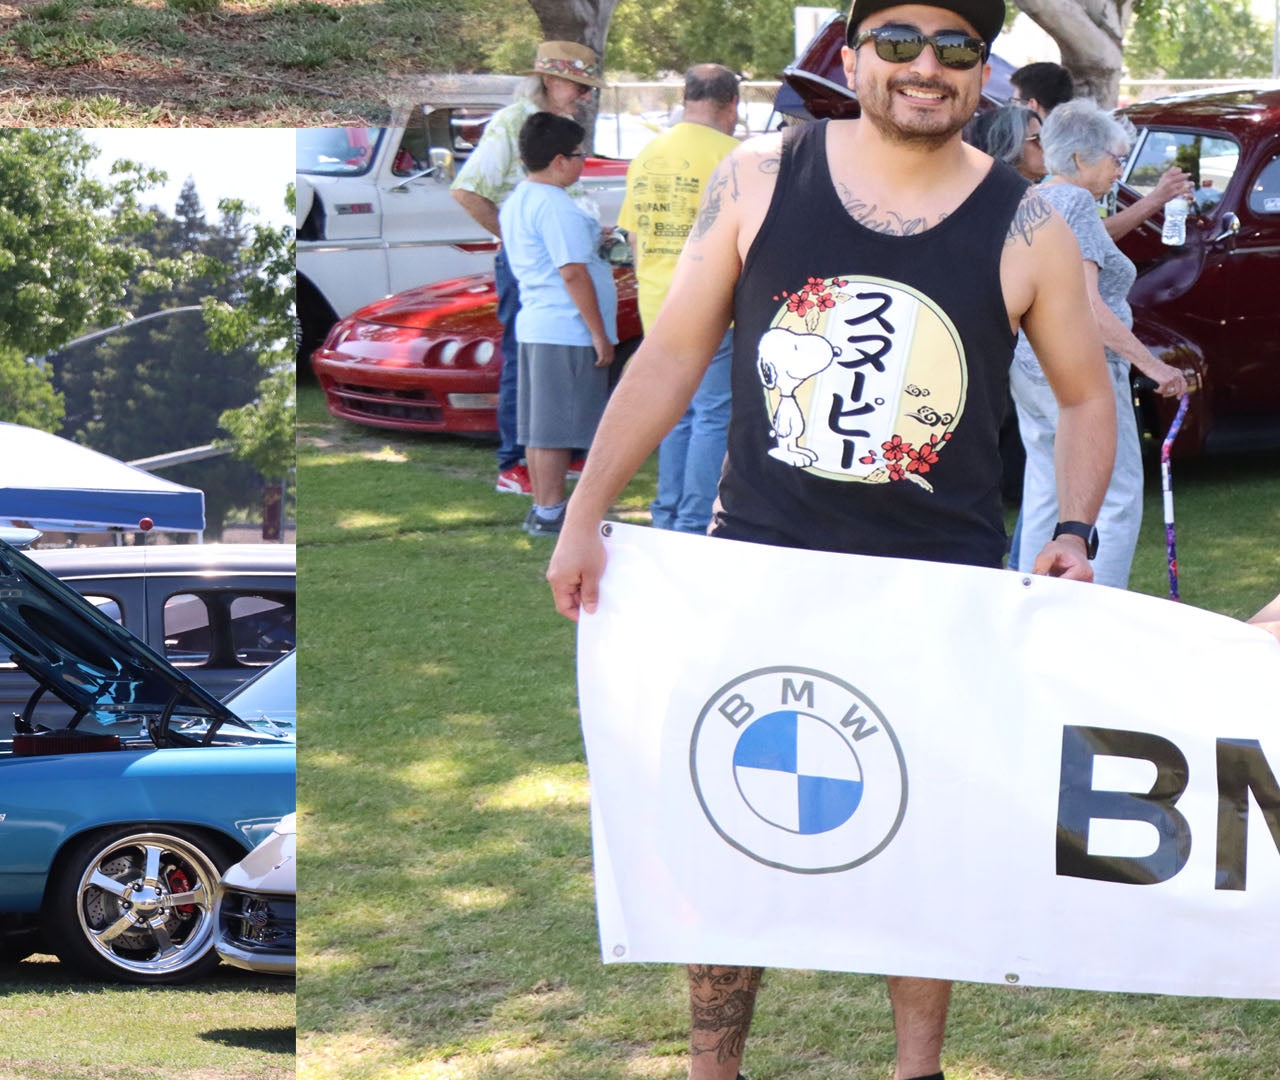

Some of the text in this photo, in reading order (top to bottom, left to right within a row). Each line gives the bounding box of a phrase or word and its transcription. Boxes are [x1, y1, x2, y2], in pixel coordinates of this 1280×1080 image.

[828, 292, 895, 470] スヌーピー
[718, 678, 879, 743] BMW
